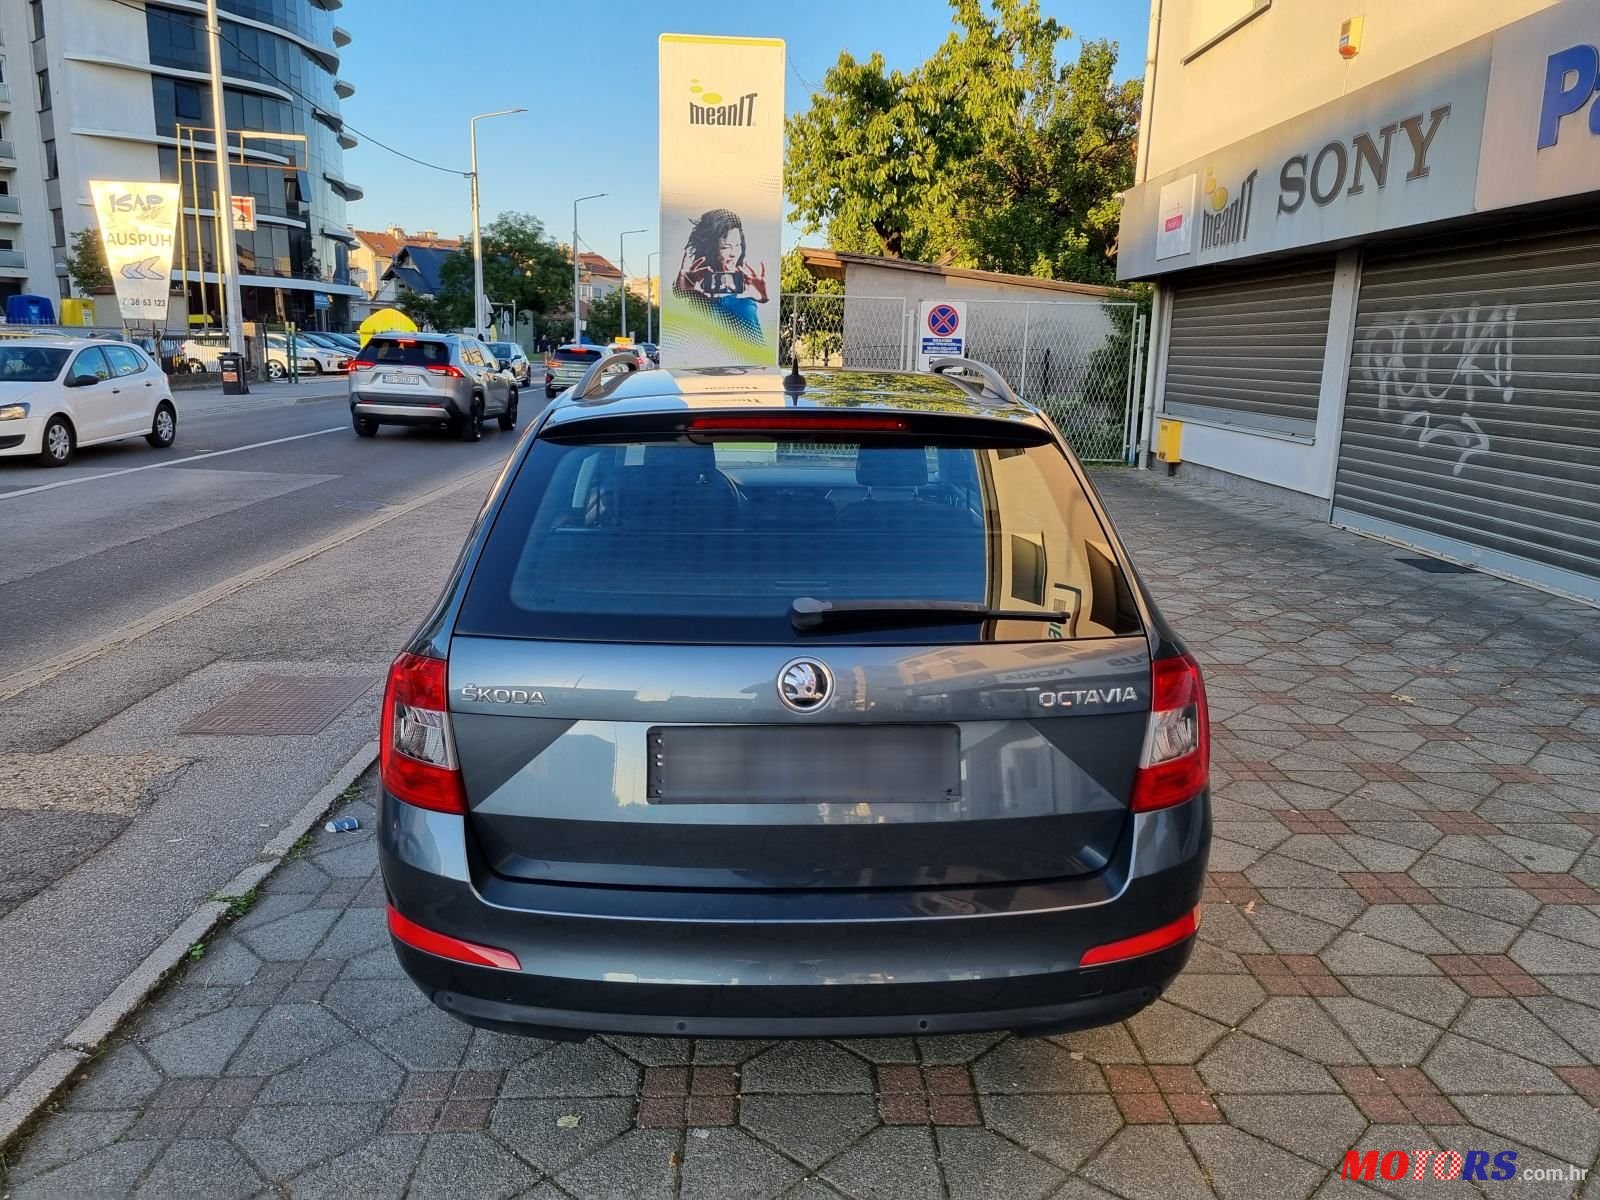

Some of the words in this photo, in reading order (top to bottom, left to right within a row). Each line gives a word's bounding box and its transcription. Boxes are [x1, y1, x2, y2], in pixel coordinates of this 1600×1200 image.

[689, 92, 758, 127] meanIT
[1277, 102, 1452, 216] SONY
[109, 193, 164, 213] ISAP
[1201, 168, 1258, 250] meanIT
[106, 232, 172, 247] AUSPUH
[130, 298, 140, 306] 38
[154, 299, 166, 307] 123
[461, 683, 547, 705] ŠKODA
[1038, 686, 1138, 707] OCTAVIA
